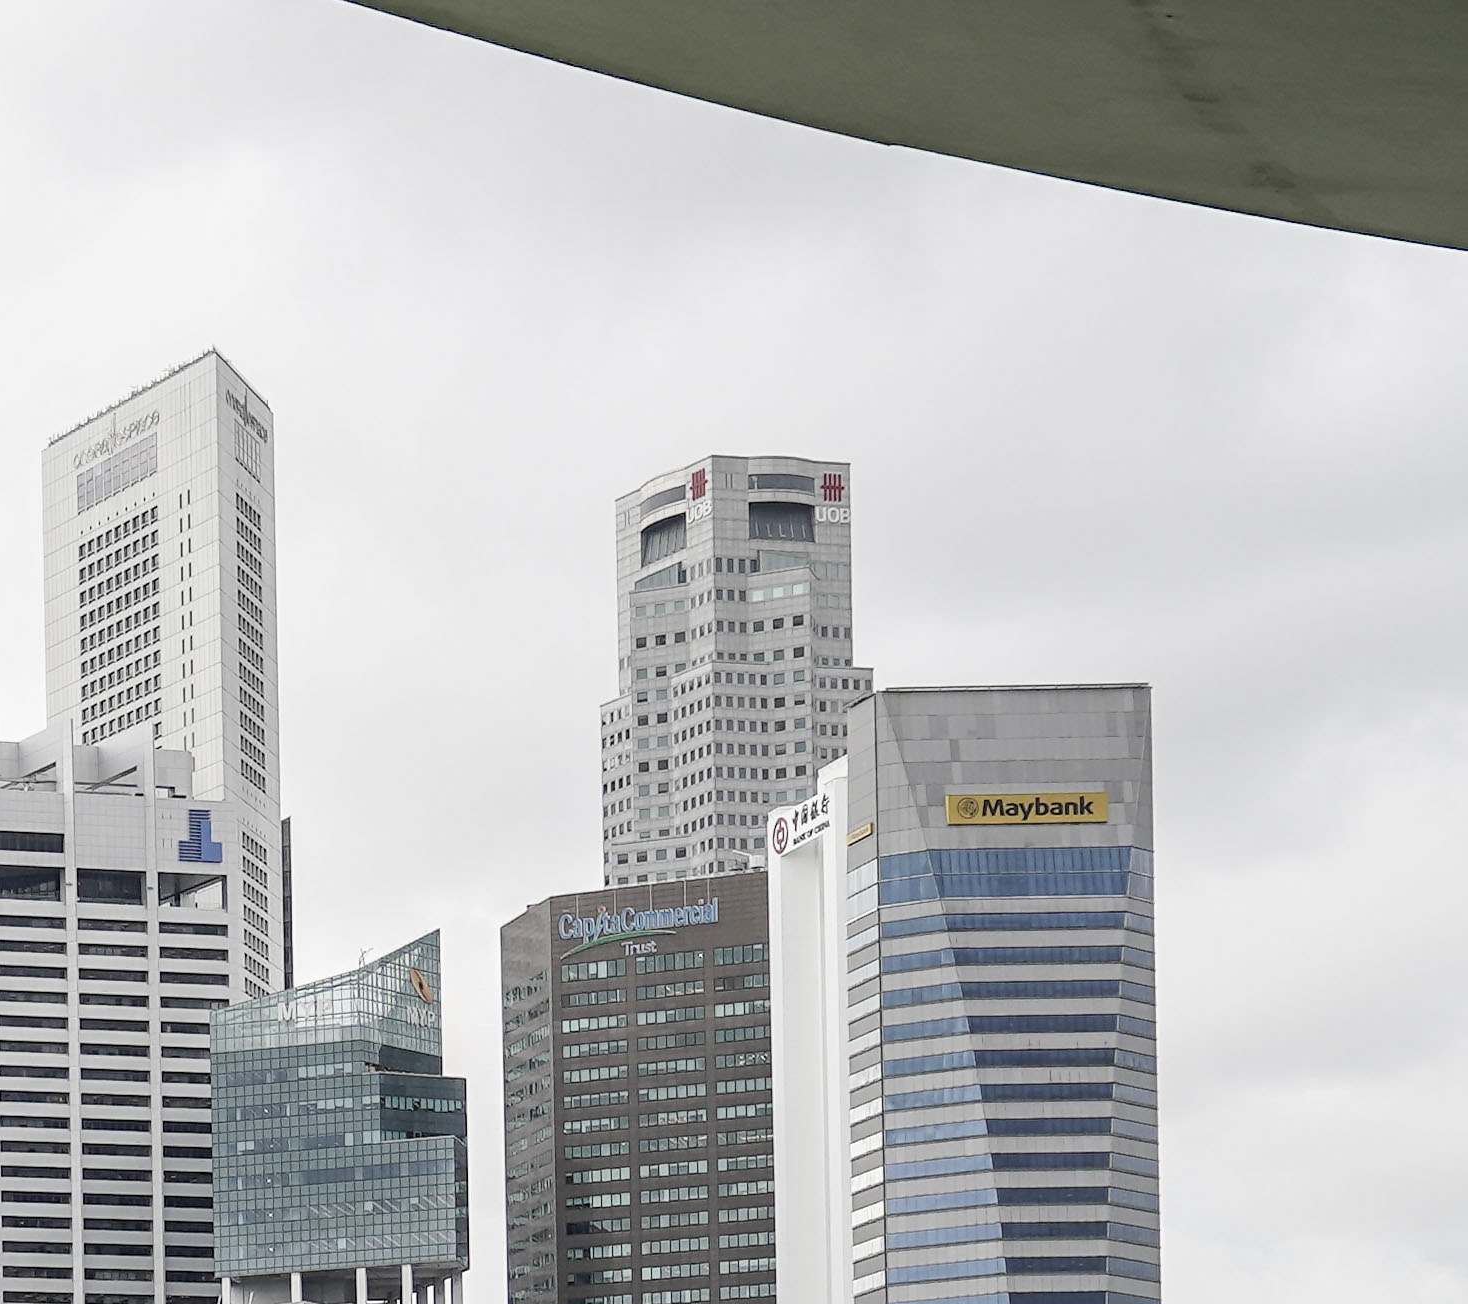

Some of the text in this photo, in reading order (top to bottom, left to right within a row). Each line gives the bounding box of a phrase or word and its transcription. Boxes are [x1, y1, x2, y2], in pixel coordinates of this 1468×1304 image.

[686, 500, 713, 525] UOB
[815, 507, 851, 524] UOB
[982, 796, 1094, 821] Maybank
[558, 897, 719, 944] CapitaCommercial
[620, 940, 658, 957] Trust
[406, 1005, 436, 1028] MYP
